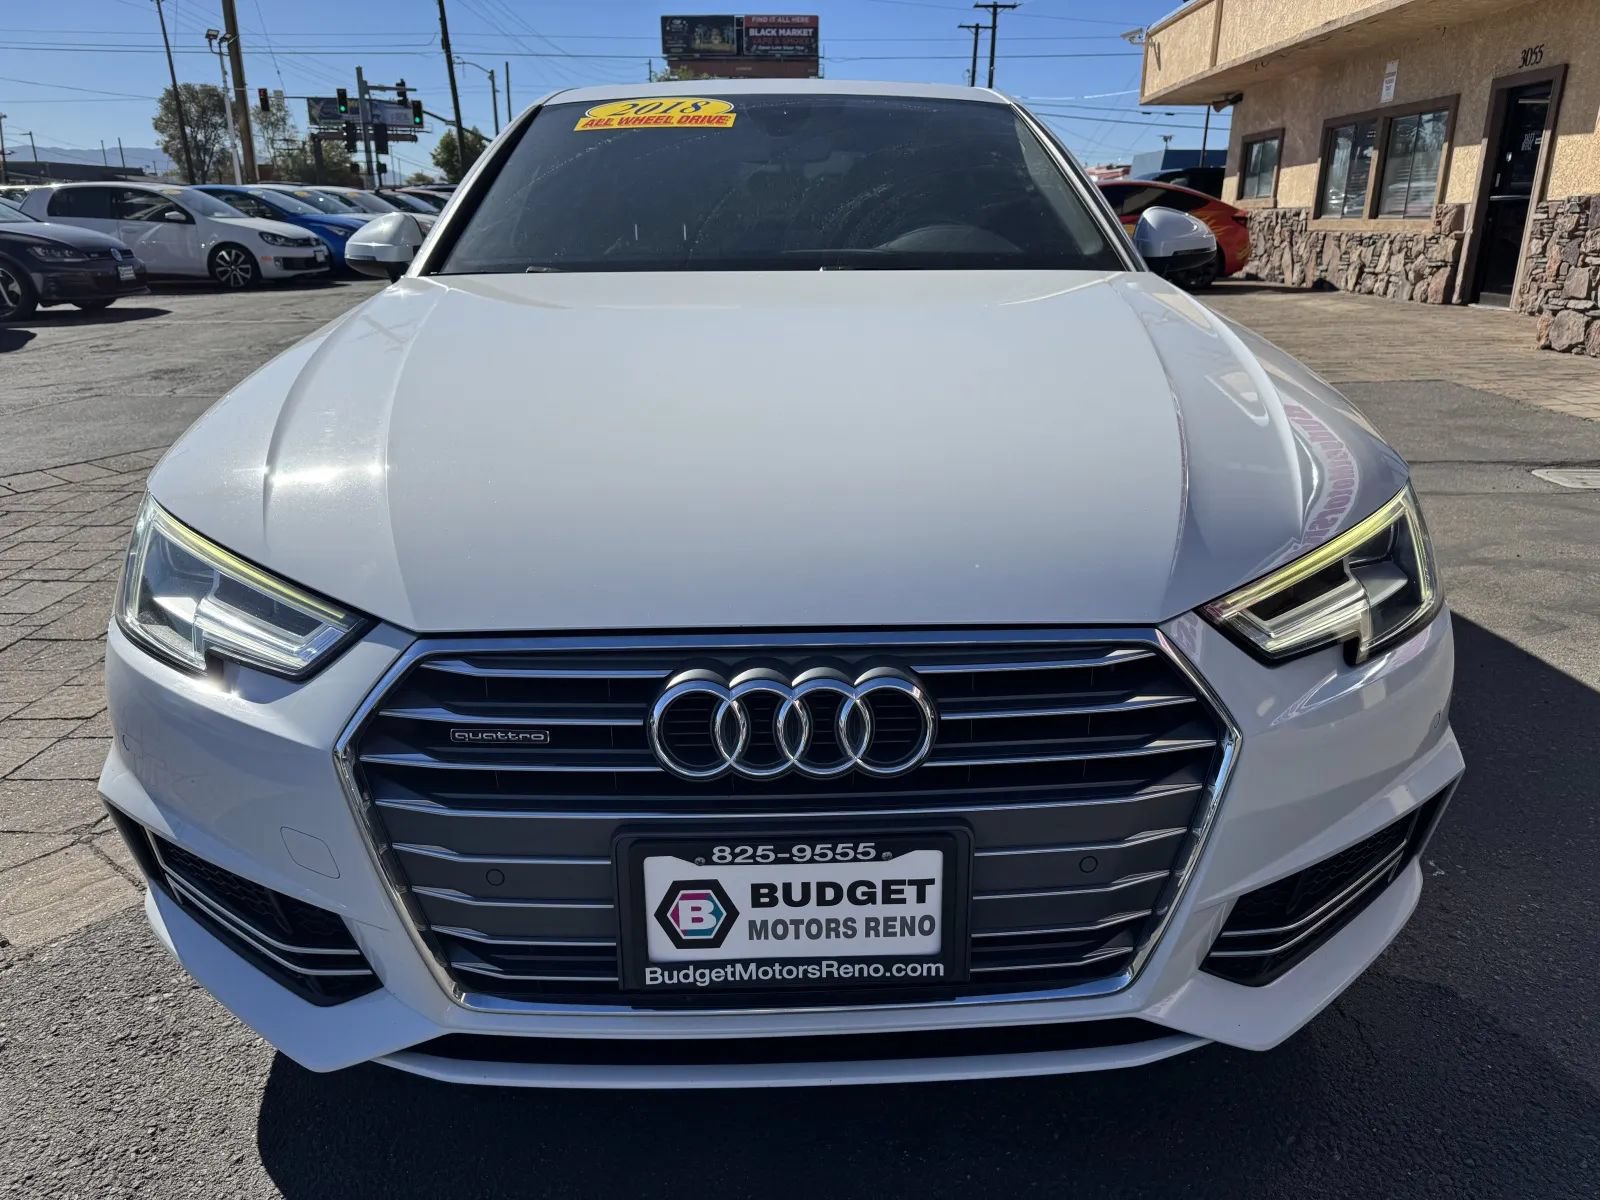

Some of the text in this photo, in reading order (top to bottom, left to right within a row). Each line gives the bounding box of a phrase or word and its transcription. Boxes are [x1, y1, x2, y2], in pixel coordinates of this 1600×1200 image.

[749, 28, 814, 37] BLACK MARKET
[1518, 44, 1545, 69] 3055
[610, 100, 711, 116] 2018
[581, 114, 731, 128] ALL WHEEL DRIVE
[454, 731, 545, 742] quattro
[711, 843, 877, 863] 825-9555
[750, 878, 936, 908] BUDGET
[678, 899, 718, 931] B
[748, 914, 937, 941] MOTORS RENO
[645, 960, 945, 987] BudgetMotorsReno.com
